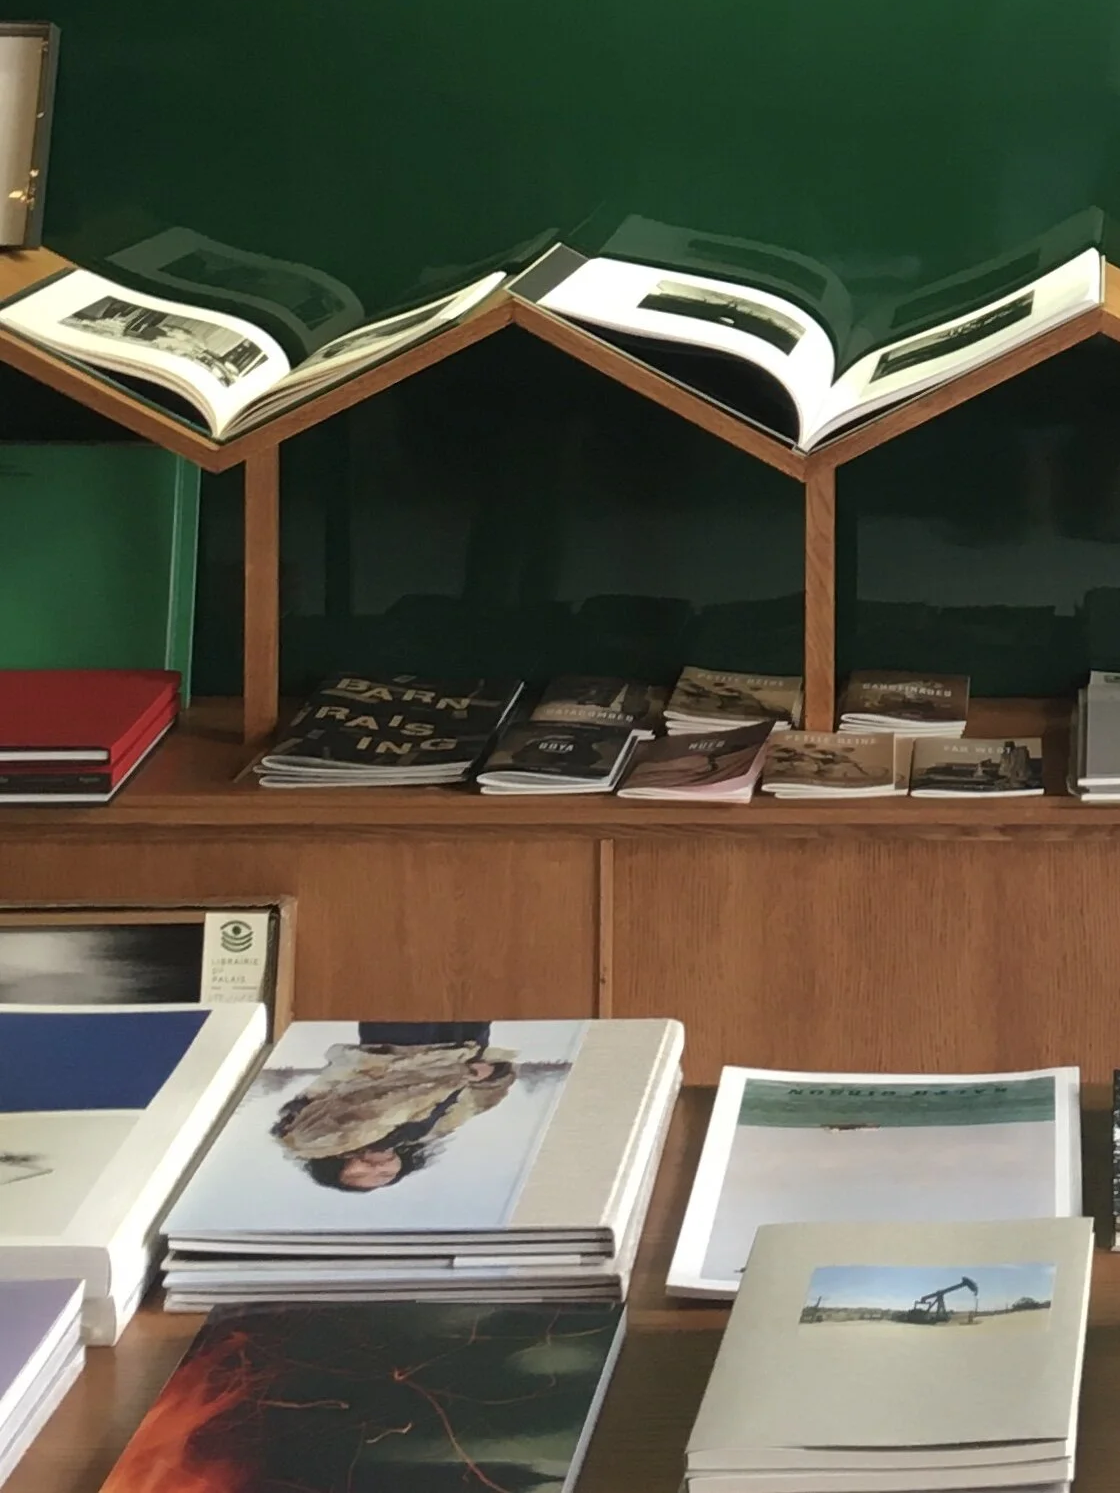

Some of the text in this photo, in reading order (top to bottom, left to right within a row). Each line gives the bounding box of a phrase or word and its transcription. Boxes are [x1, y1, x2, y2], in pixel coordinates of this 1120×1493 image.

[335, 678, 470, 709] BARN
[314, 707, 435, 736] RAIS
[356, 737, 457, 755] ING
